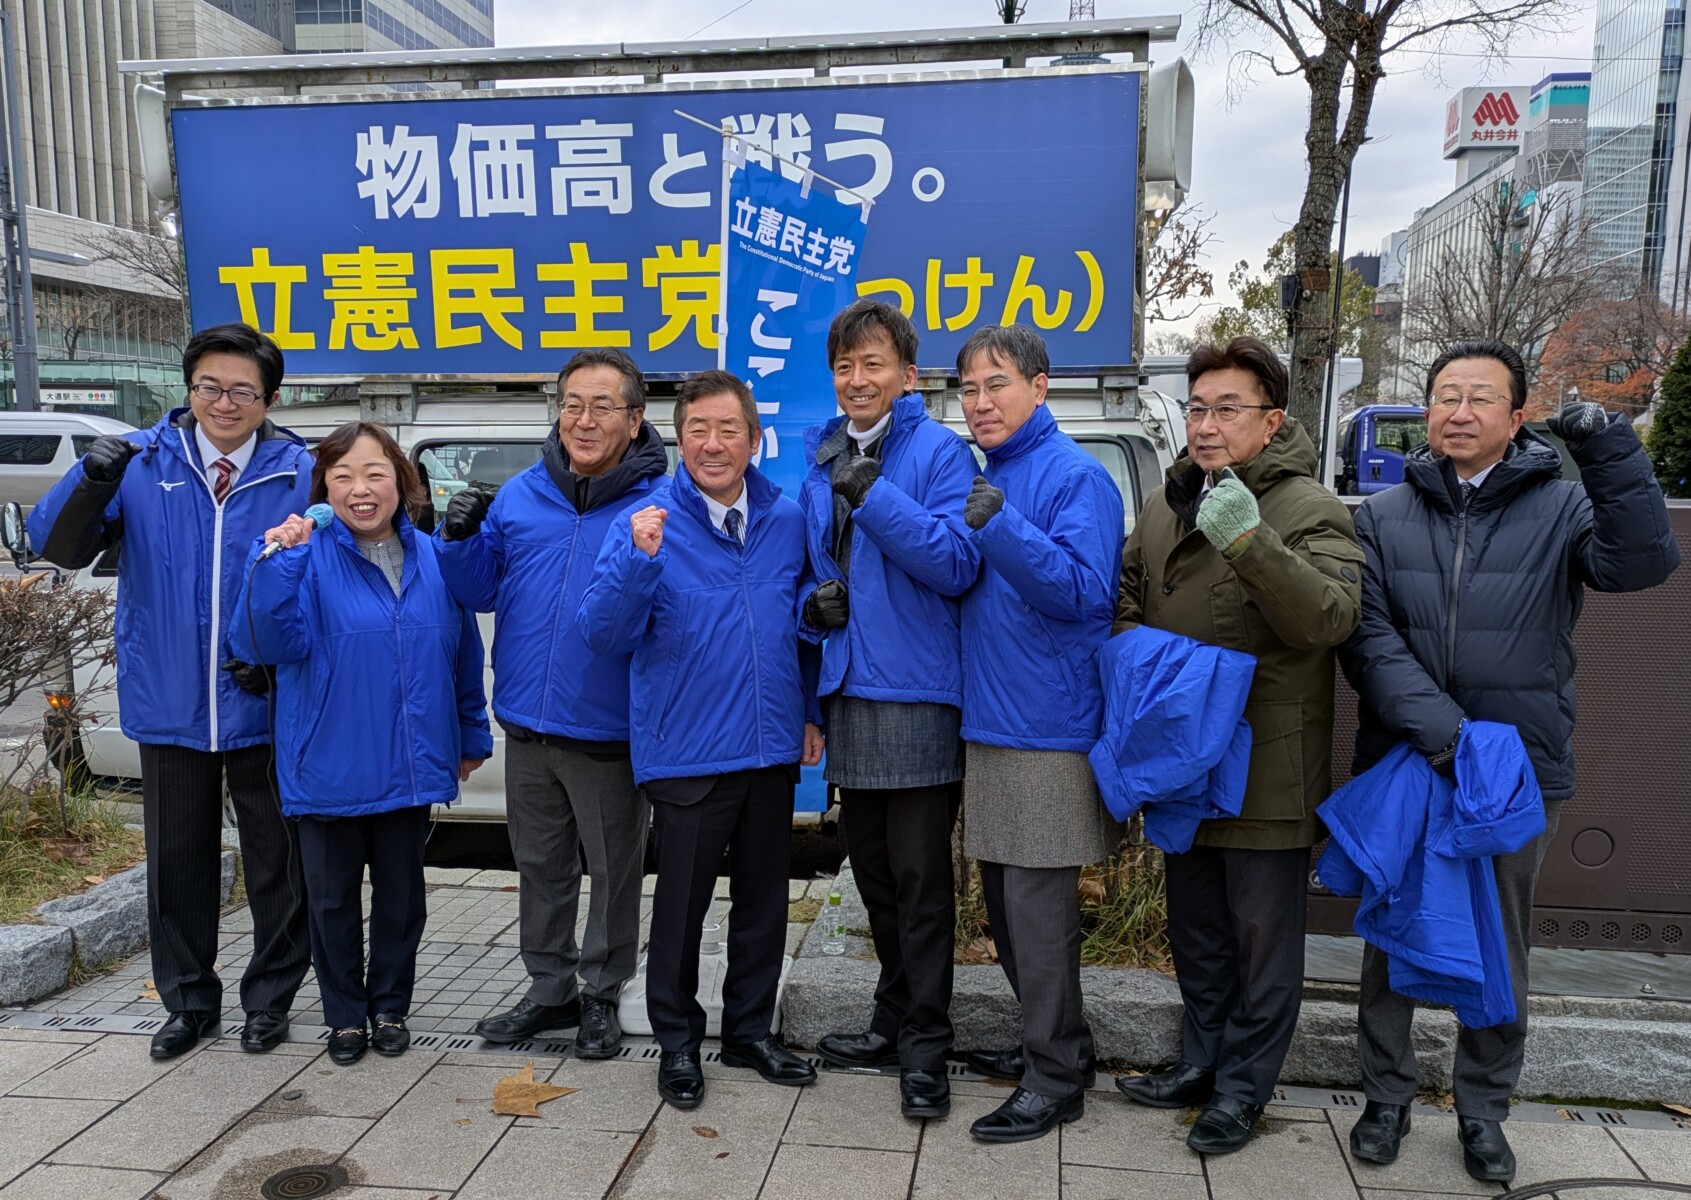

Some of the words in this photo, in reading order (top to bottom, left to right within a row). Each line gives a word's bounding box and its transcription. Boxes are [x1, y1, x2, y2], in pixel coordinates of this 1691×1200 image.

[1471, 129, 1519, 141] 丸井今井
[355, 112, 946, 219] 物価高と戦う。
[731, 196, 855, 275] 立憲民主党
[739, 241, 747, 250] The
[747, 244, 778, 262] Constitutional
[778, 256, 803, 272] Democratic
[803, 266, 814, 278] Party
[819, 273, 835, 283] Japan
[46, 392, 71, 401] 大通駅
